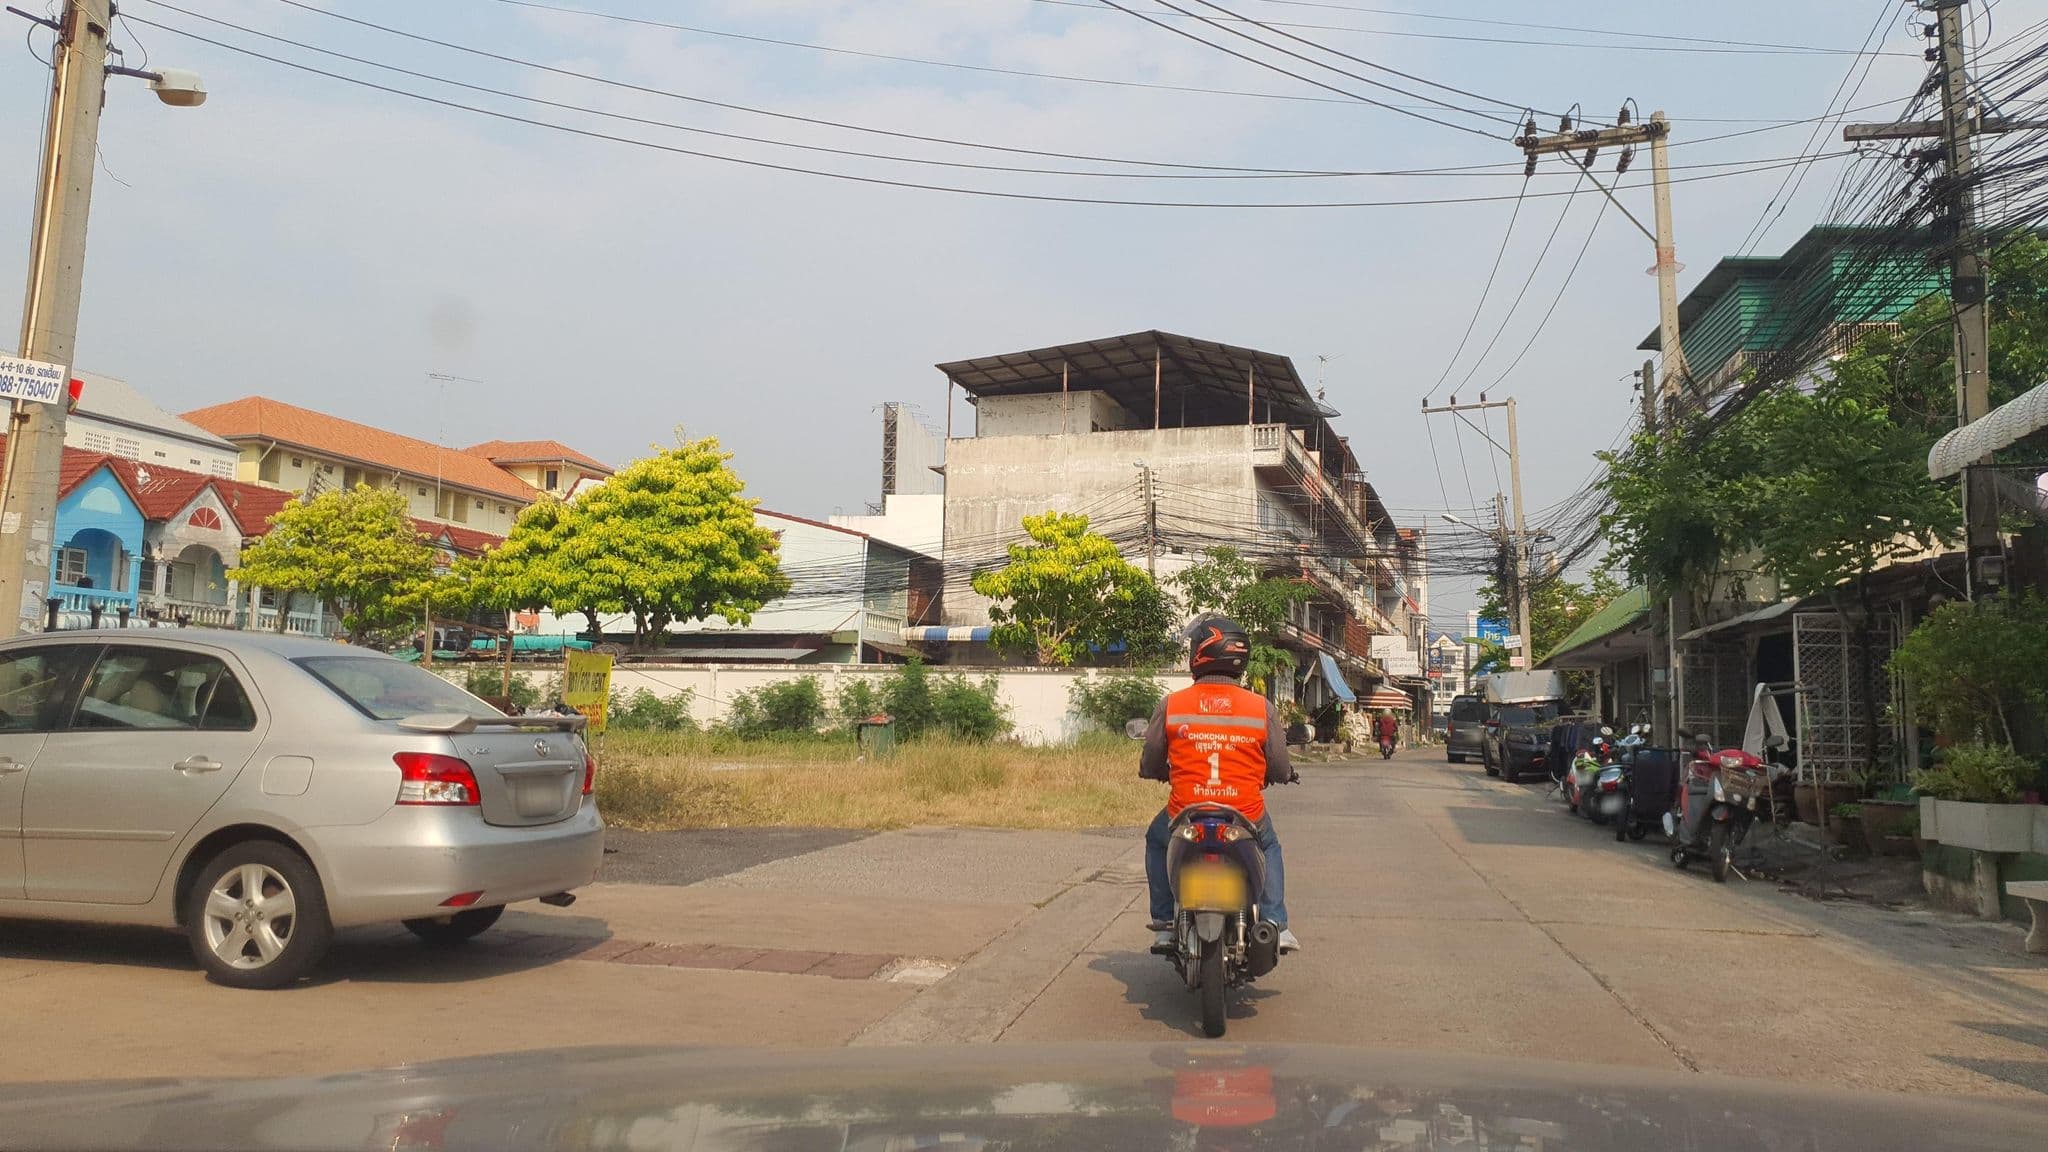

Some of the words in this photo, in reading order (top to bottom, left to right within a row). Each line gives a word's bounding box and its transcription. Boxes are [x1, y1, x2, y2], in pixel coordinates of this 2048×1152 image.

[1188, 732, 1227, 741] CHOKCHAI
[1230, 735, 1256, 744] GROUP
[1207, 752, 1221, 786] 1
